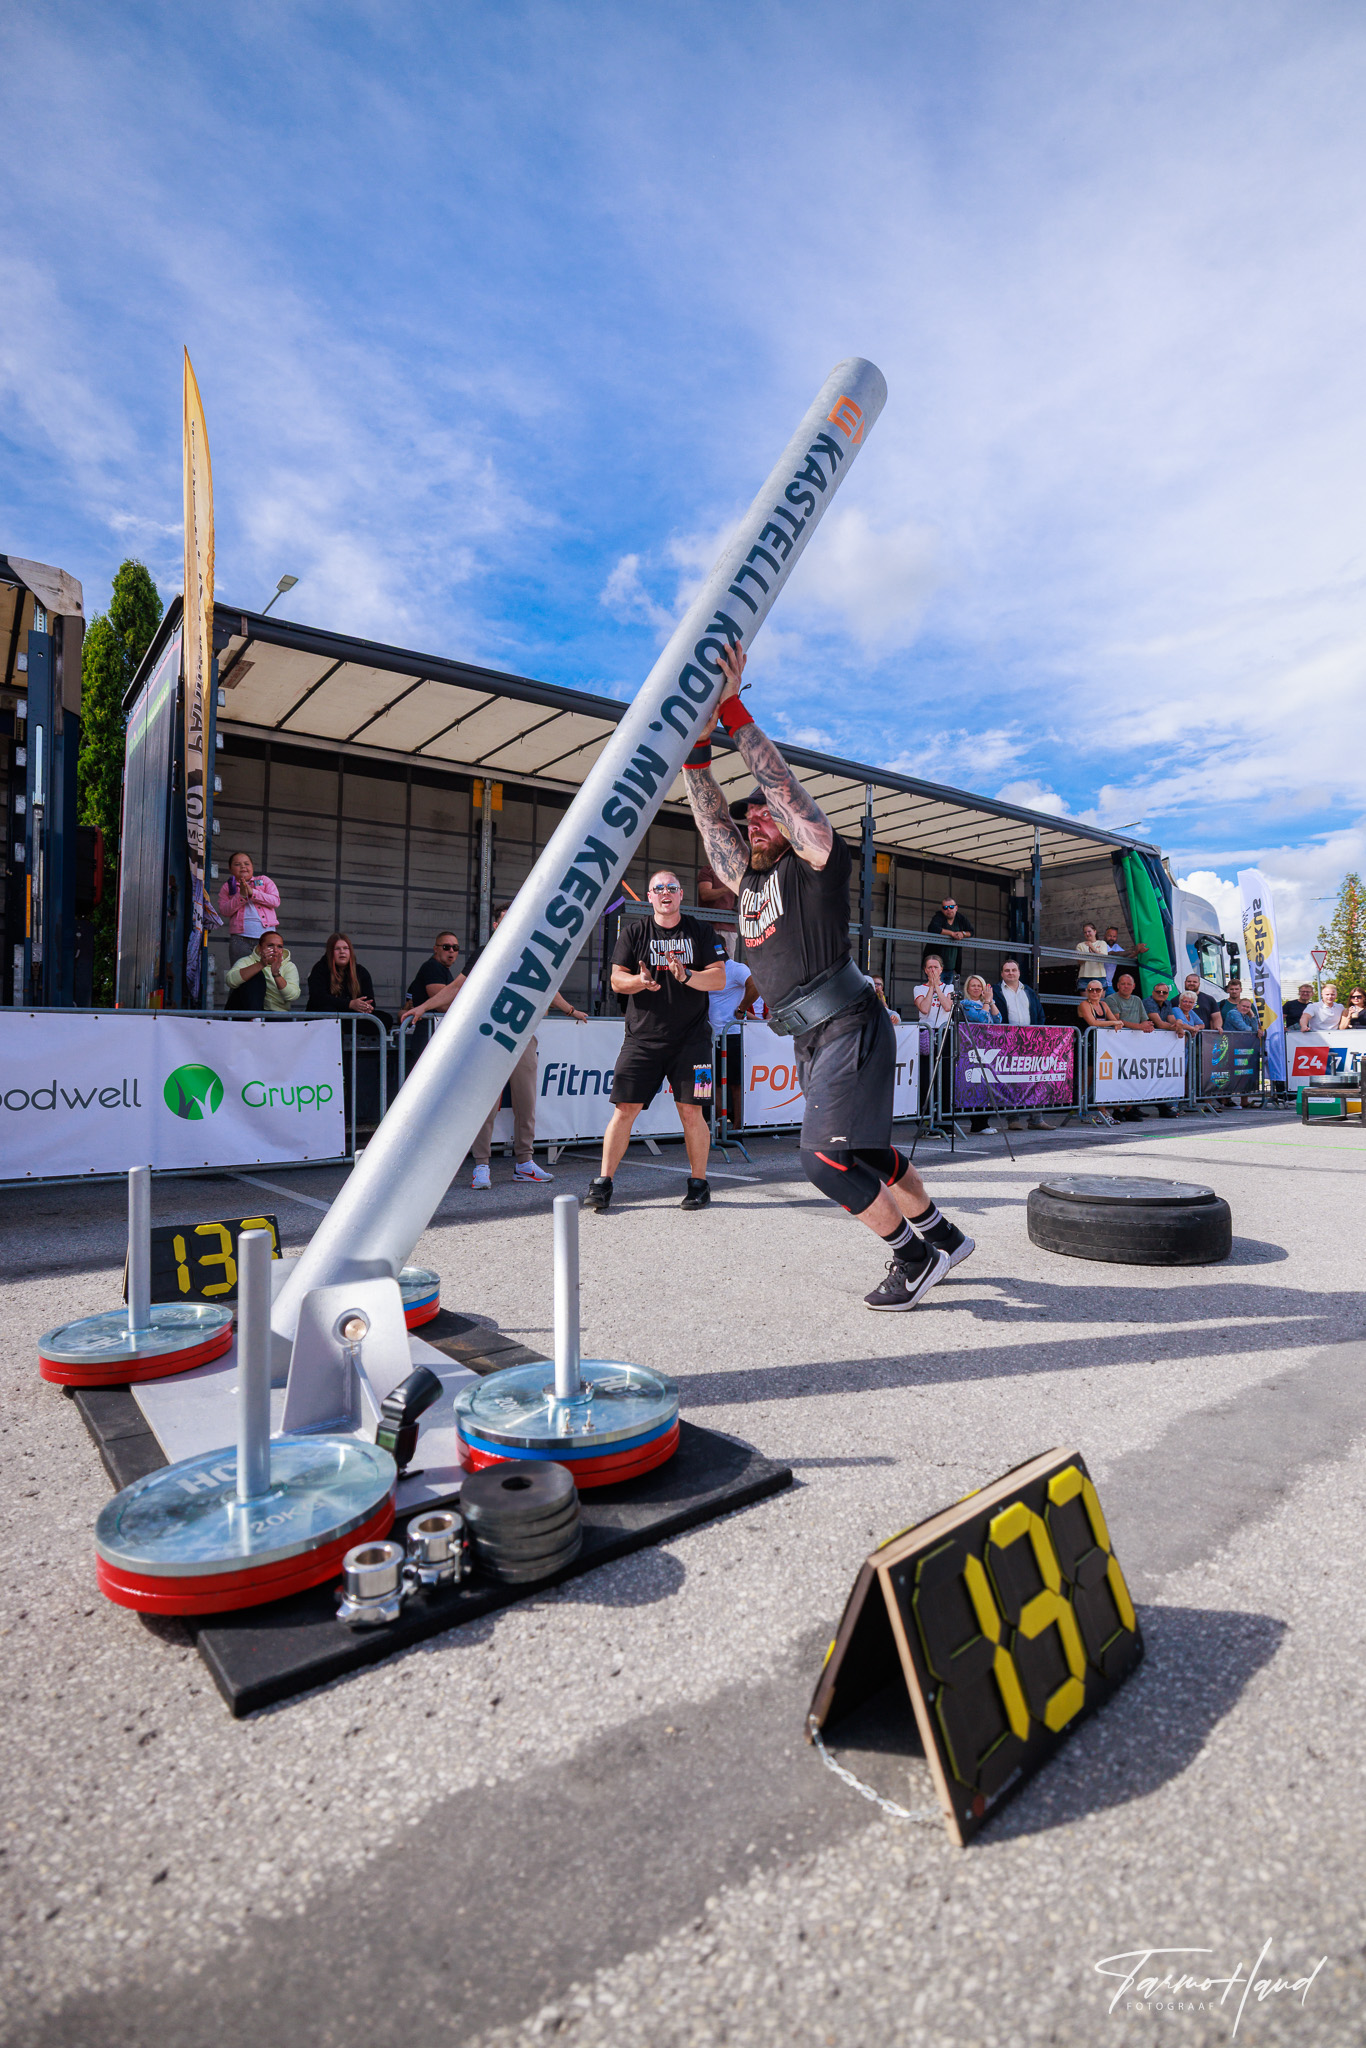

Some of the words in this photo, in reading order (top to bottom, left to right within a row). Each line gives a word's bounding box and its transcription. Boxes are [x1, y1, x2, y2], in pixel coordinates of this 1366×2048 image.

[728, 433, 845, 616] KASTELLI
[649, 610, 745, 741] KODU,
[602, 743, 670, 839] MIS
[479, 834, 620, 1054] KESTAB!
[995, 1056, 1068, 1073] KLEEBIKUM.EE
[1117, 1057, 1184, 1080] KASTELLI
[1297, 1055, 1323, 1070] 24
[0, 1078, 142, 1111] odwell
[241, 1080, 333, 1113] Grupp
